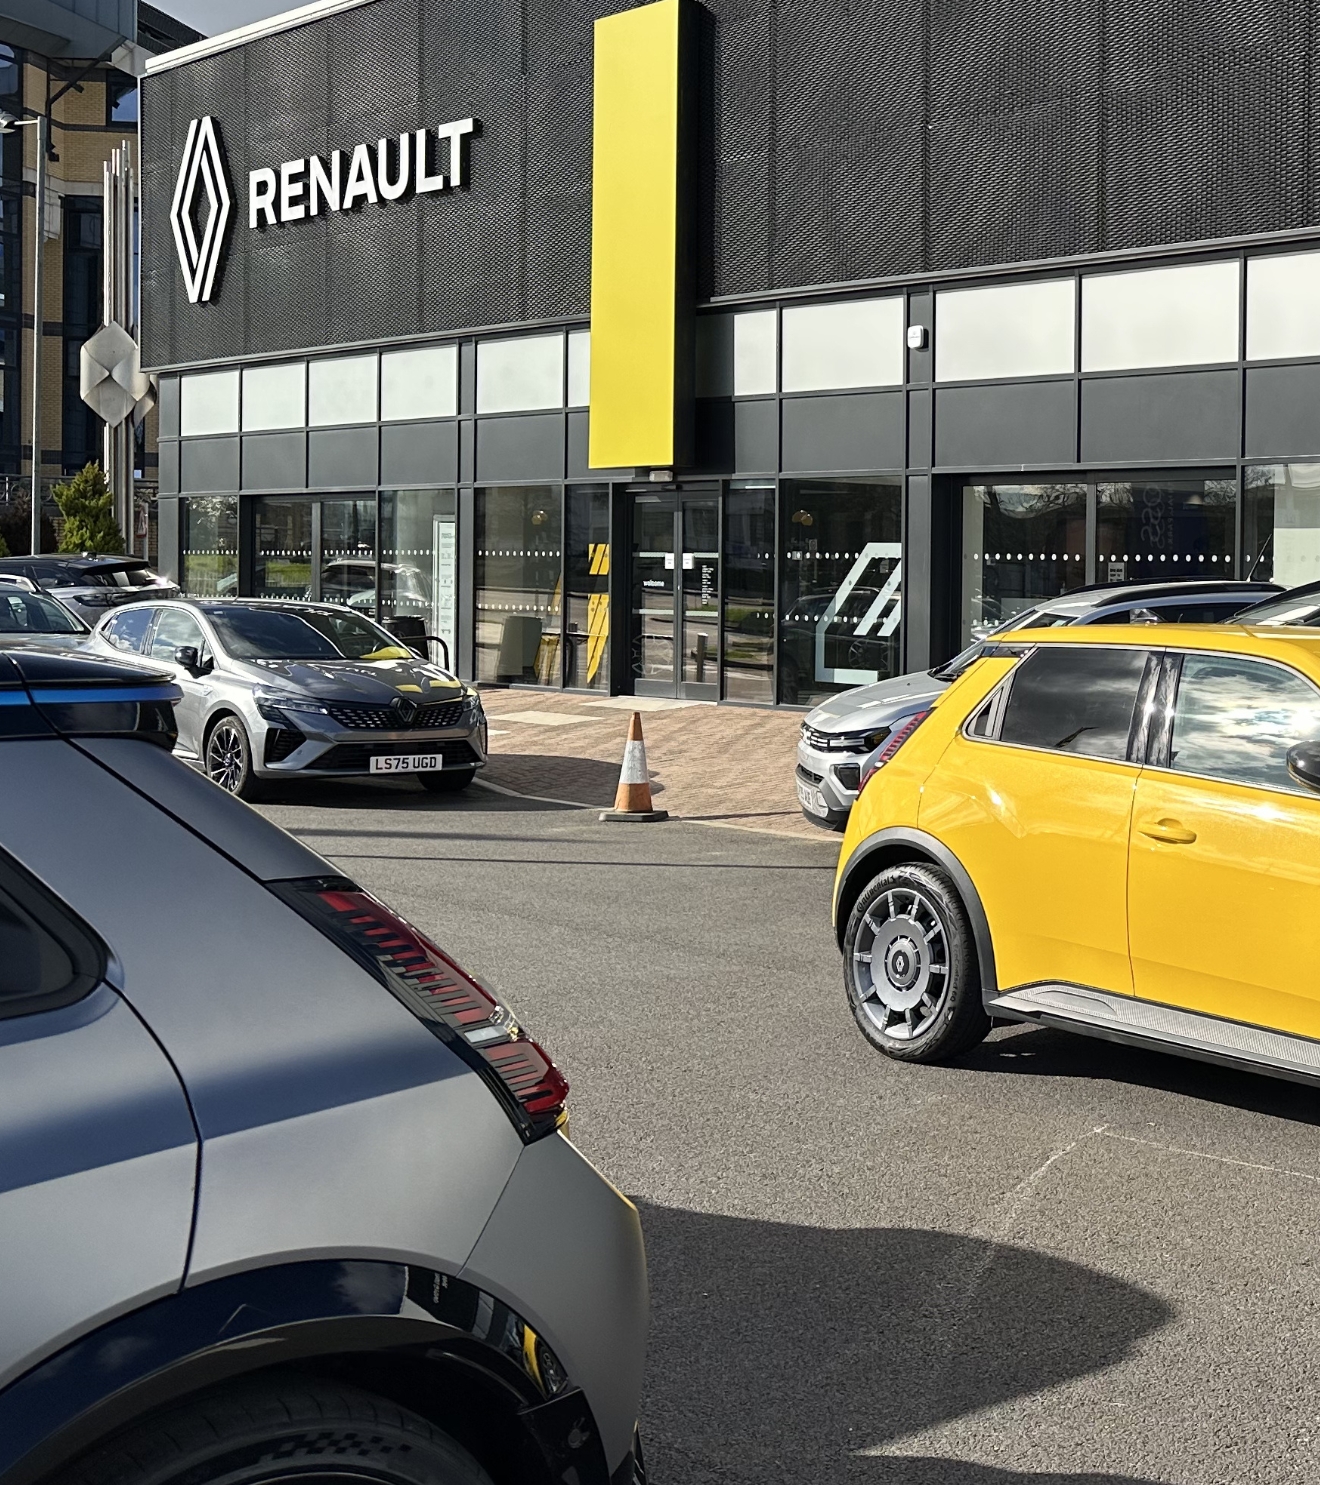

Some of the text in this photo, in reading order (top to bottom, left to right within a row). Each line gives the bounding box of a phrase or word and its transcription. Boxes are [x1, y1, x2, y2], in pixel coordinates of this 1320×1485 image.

[249, 117, 474, 229] RENAULT
[375, 757, 436, 770] LS75 UGD
